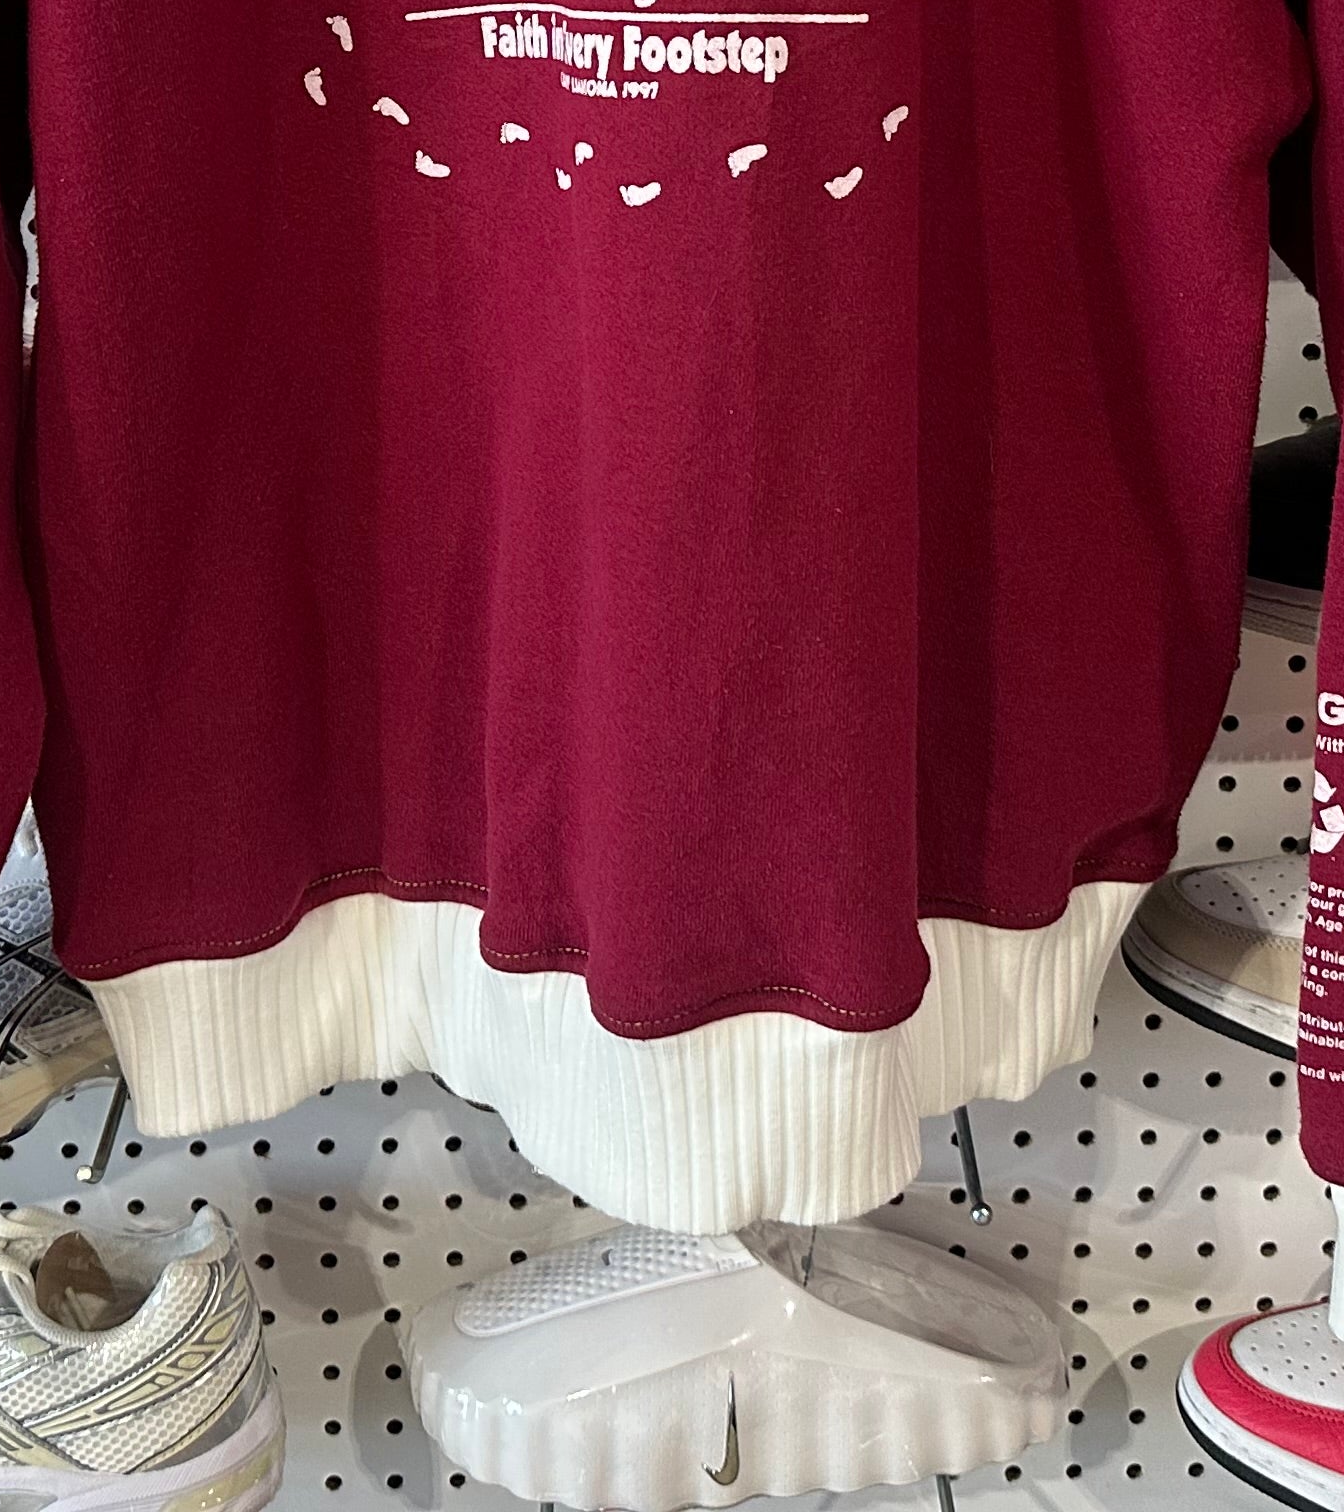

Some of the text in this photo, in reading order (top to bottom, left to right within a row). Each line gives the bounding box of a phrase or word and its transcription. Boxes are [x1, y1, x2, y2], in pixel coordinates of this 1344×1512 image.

[481, 13, 548, 58] Faith
[623, 25, 788, 83] Footstep
[1299, 1064, 1326, 1080] and
